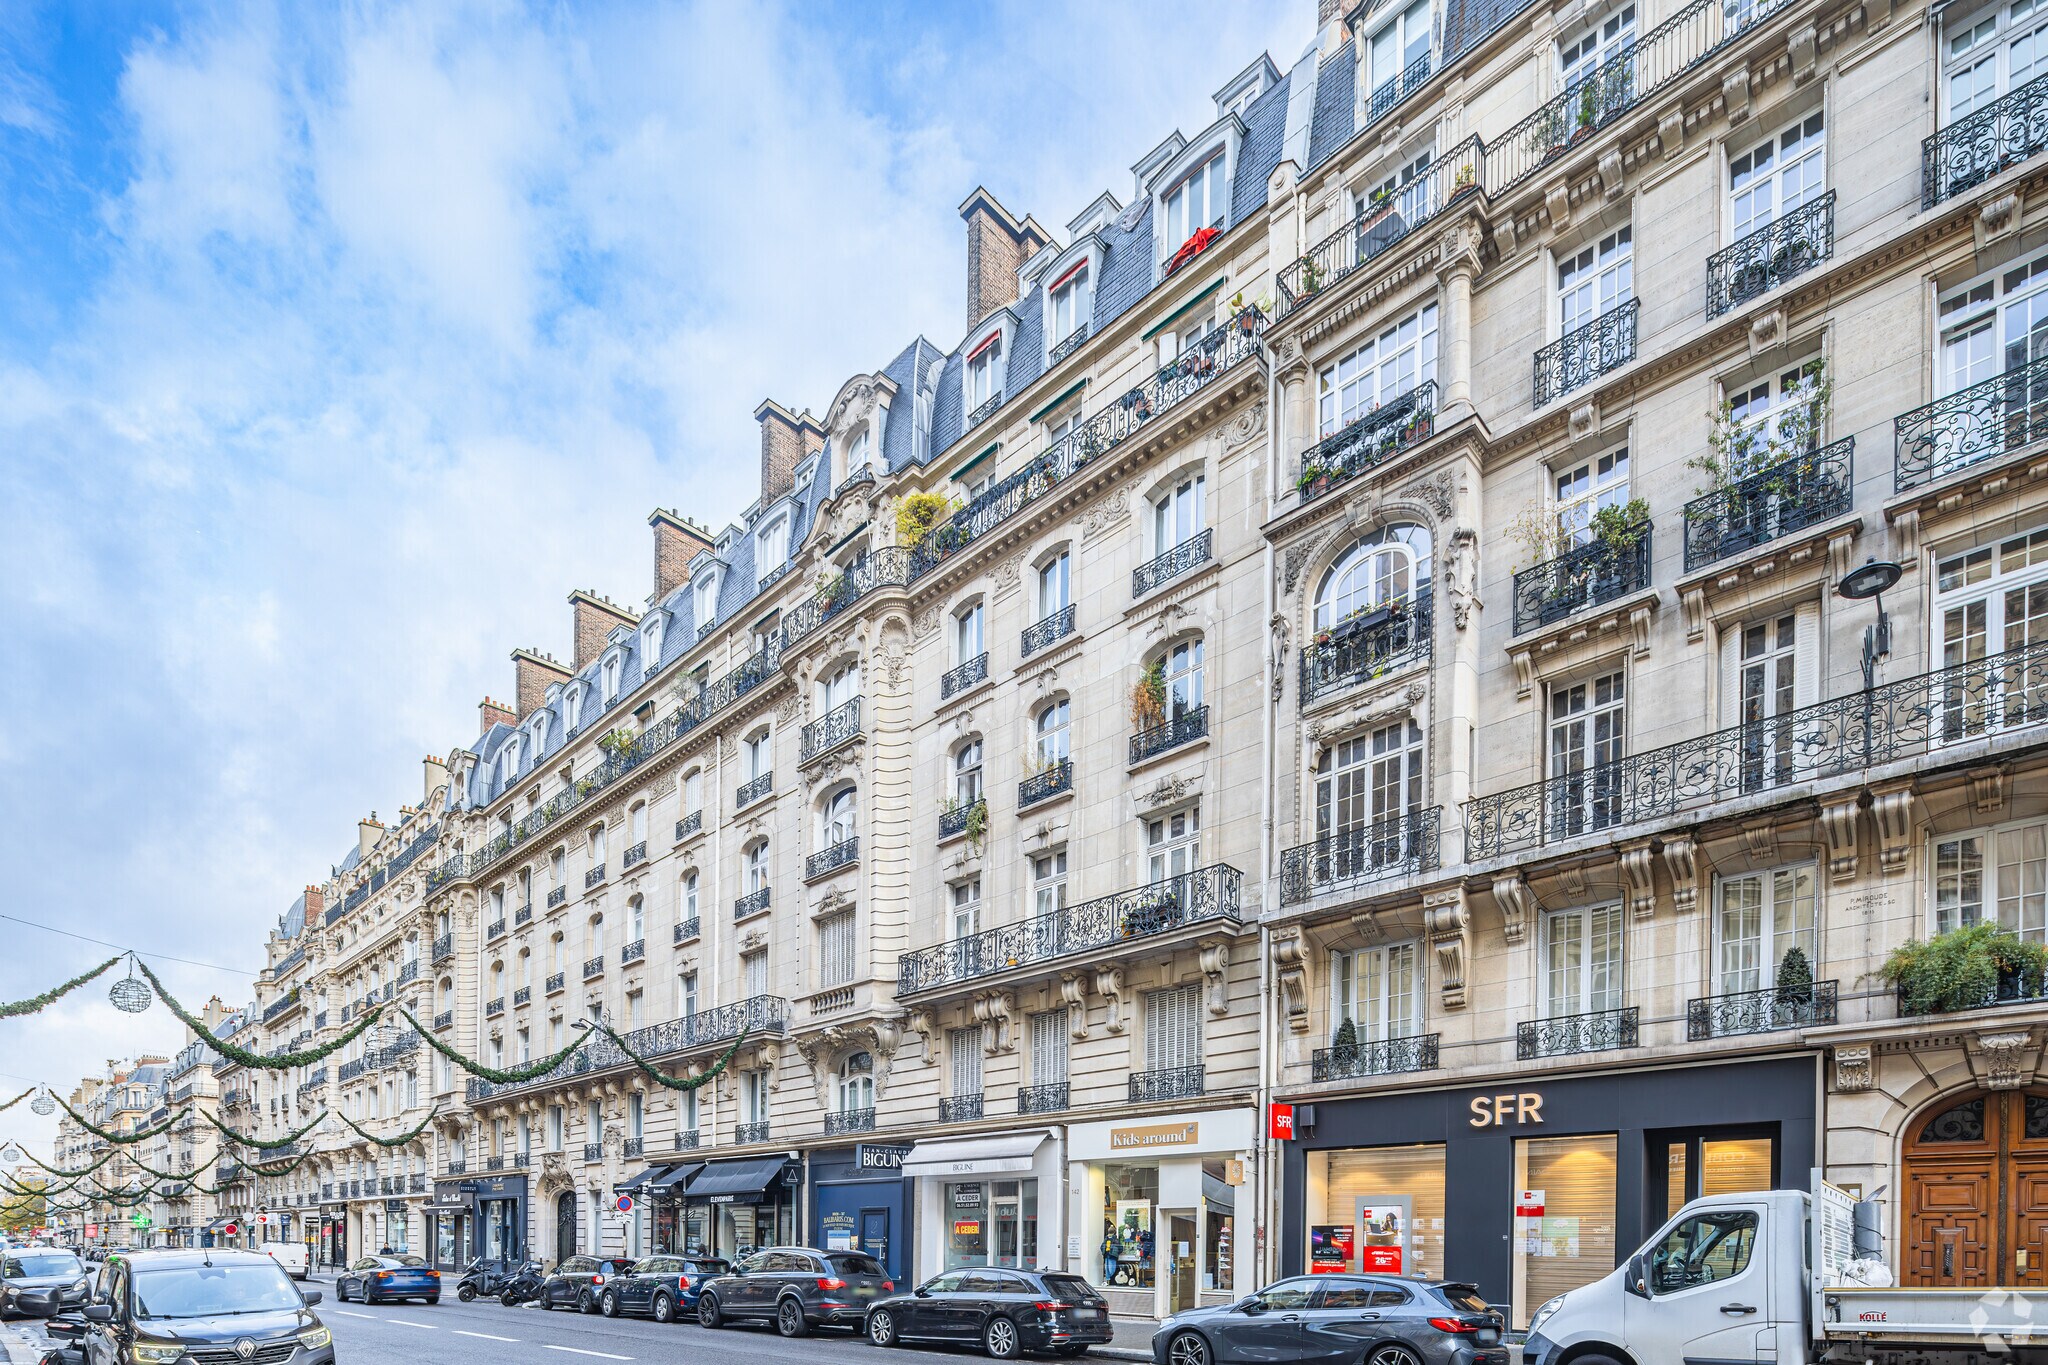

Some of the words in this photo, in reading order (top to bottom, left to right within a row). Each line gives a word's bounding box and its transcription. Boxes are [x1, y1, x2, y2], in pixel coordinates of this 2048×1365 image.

[1470, 1093, 1544, 1127] SFR
[1277, 1115, 1292, 1128] SFR
[1113, 1133, 1140, 1146] Kids
[1143, 1129, 1187, 1145] around
[863, 1152, 907, 1167] BIGUIN
[961, 1194, 979, 1202] CEDER
[961, 1225, 979, 1234] CEDER
[1859, 1311, 1887, 1322] KOLLÉ
